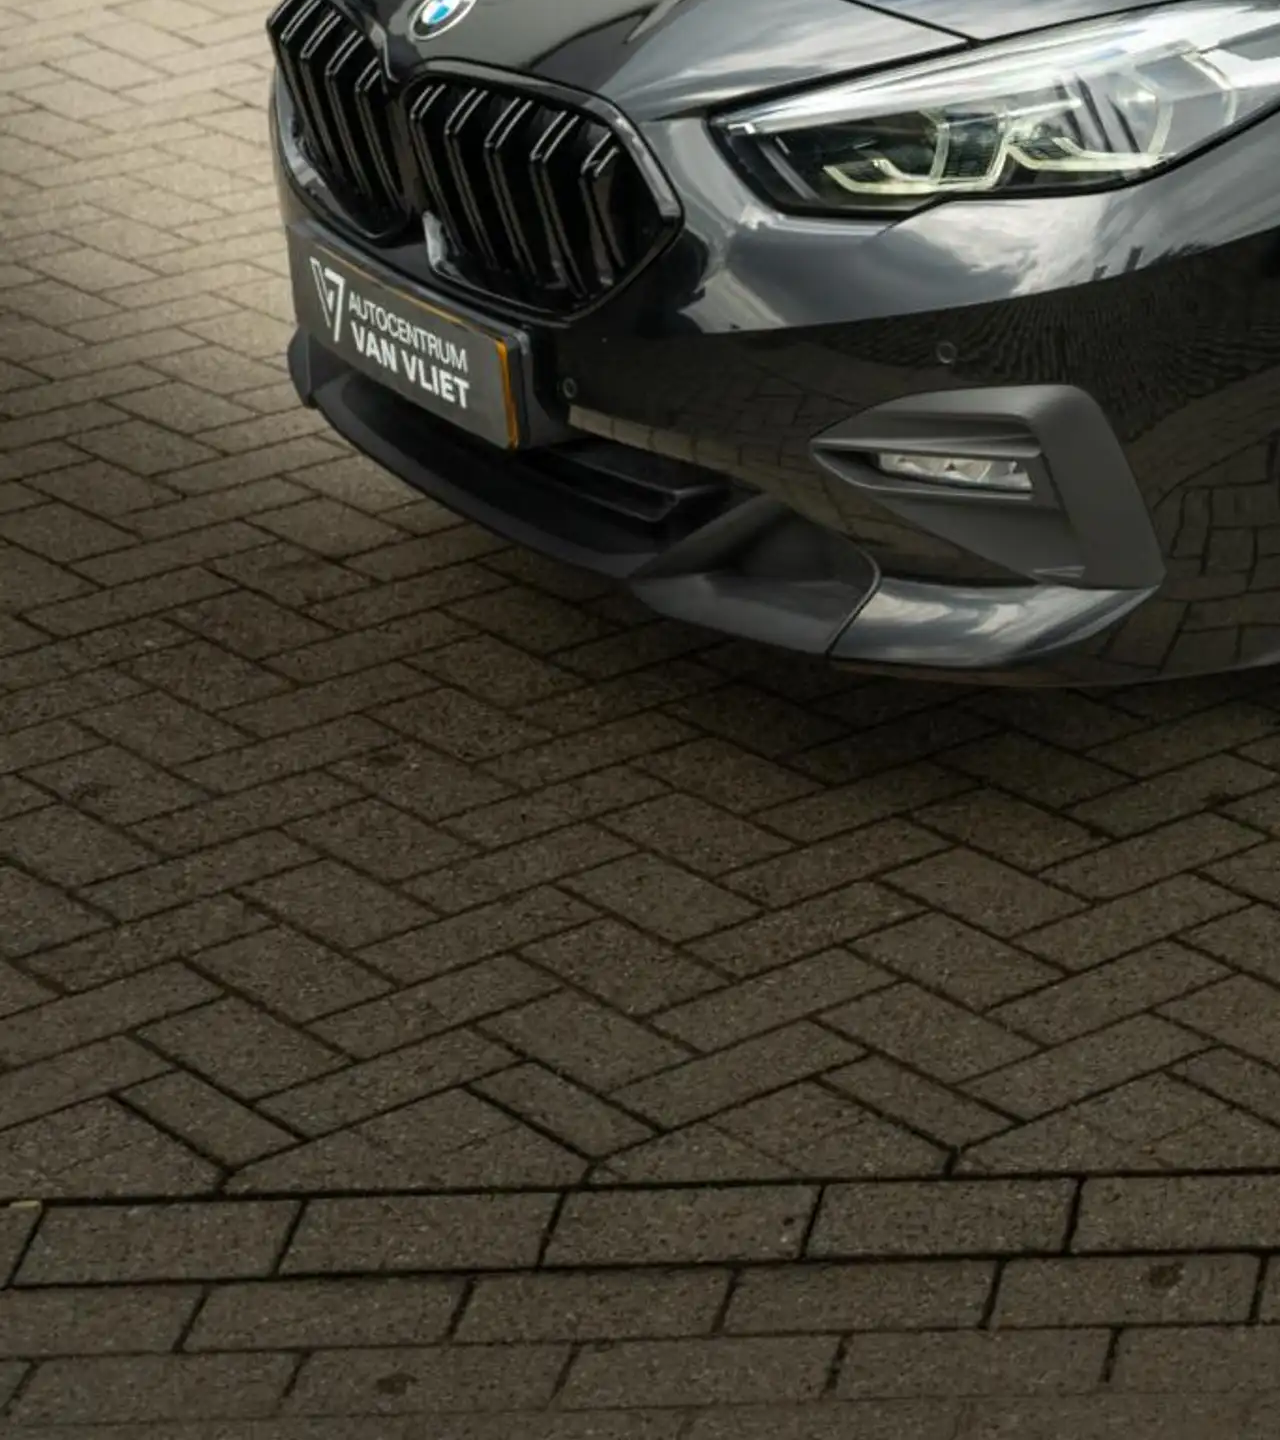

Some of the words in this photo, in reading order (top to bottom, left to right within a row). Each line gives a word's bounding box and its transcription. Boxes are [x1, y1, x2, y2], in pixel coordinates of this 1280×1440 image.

[349, 291, 468, 373] AUTOCENTRUM
[351, 321, 399, 373] VAN
[401, 350, 469, 408] VLIET
